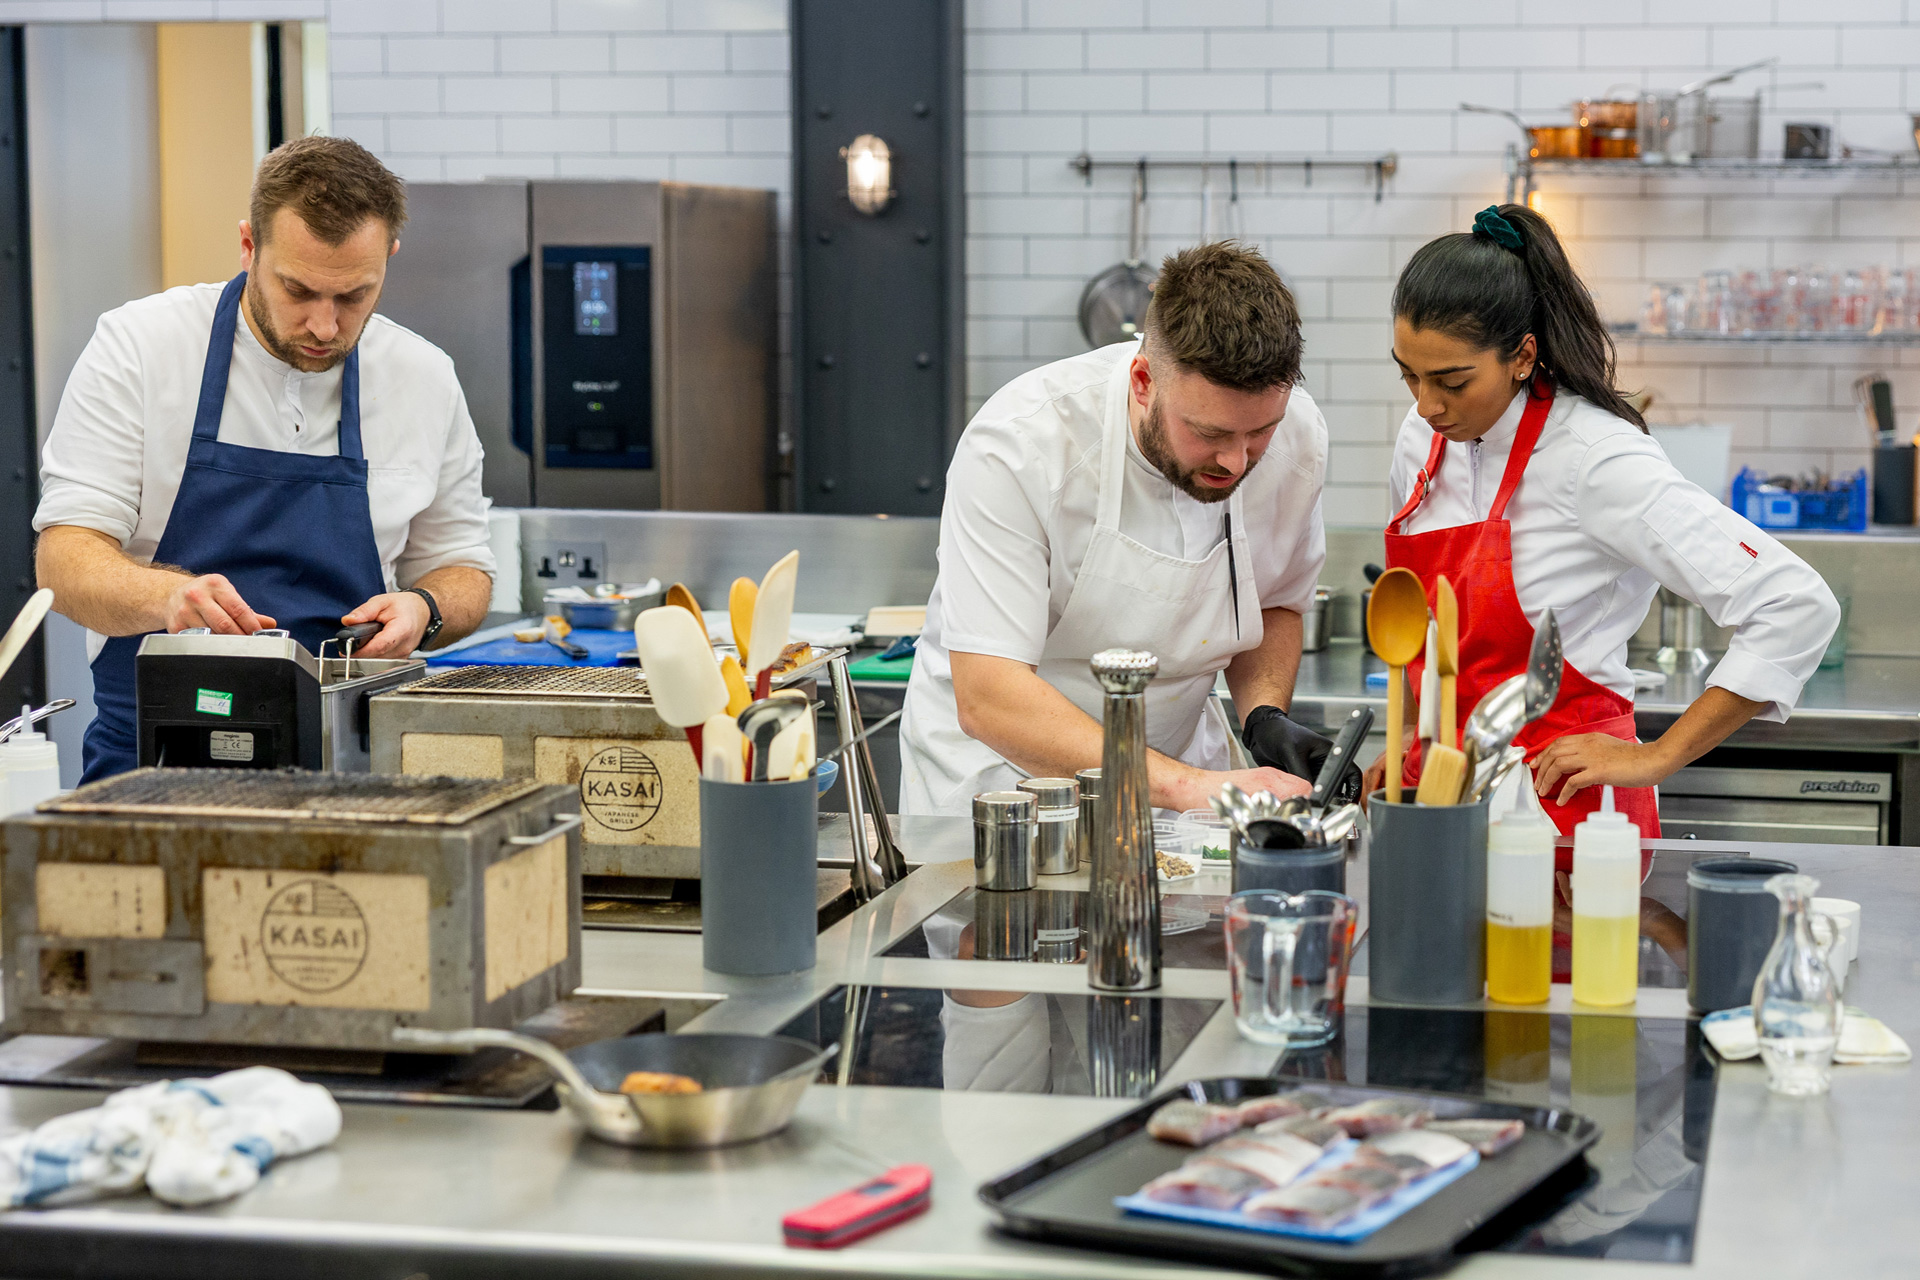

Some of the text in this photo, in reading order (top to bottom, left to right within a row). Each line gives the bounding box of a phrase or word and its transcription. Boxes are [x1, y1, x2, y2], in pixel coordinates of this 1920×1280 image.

[588, 780, 655, 798] KASAI
[1800, 780, 1881, 794] precision
[270, 924, 359, 949] KASAI
